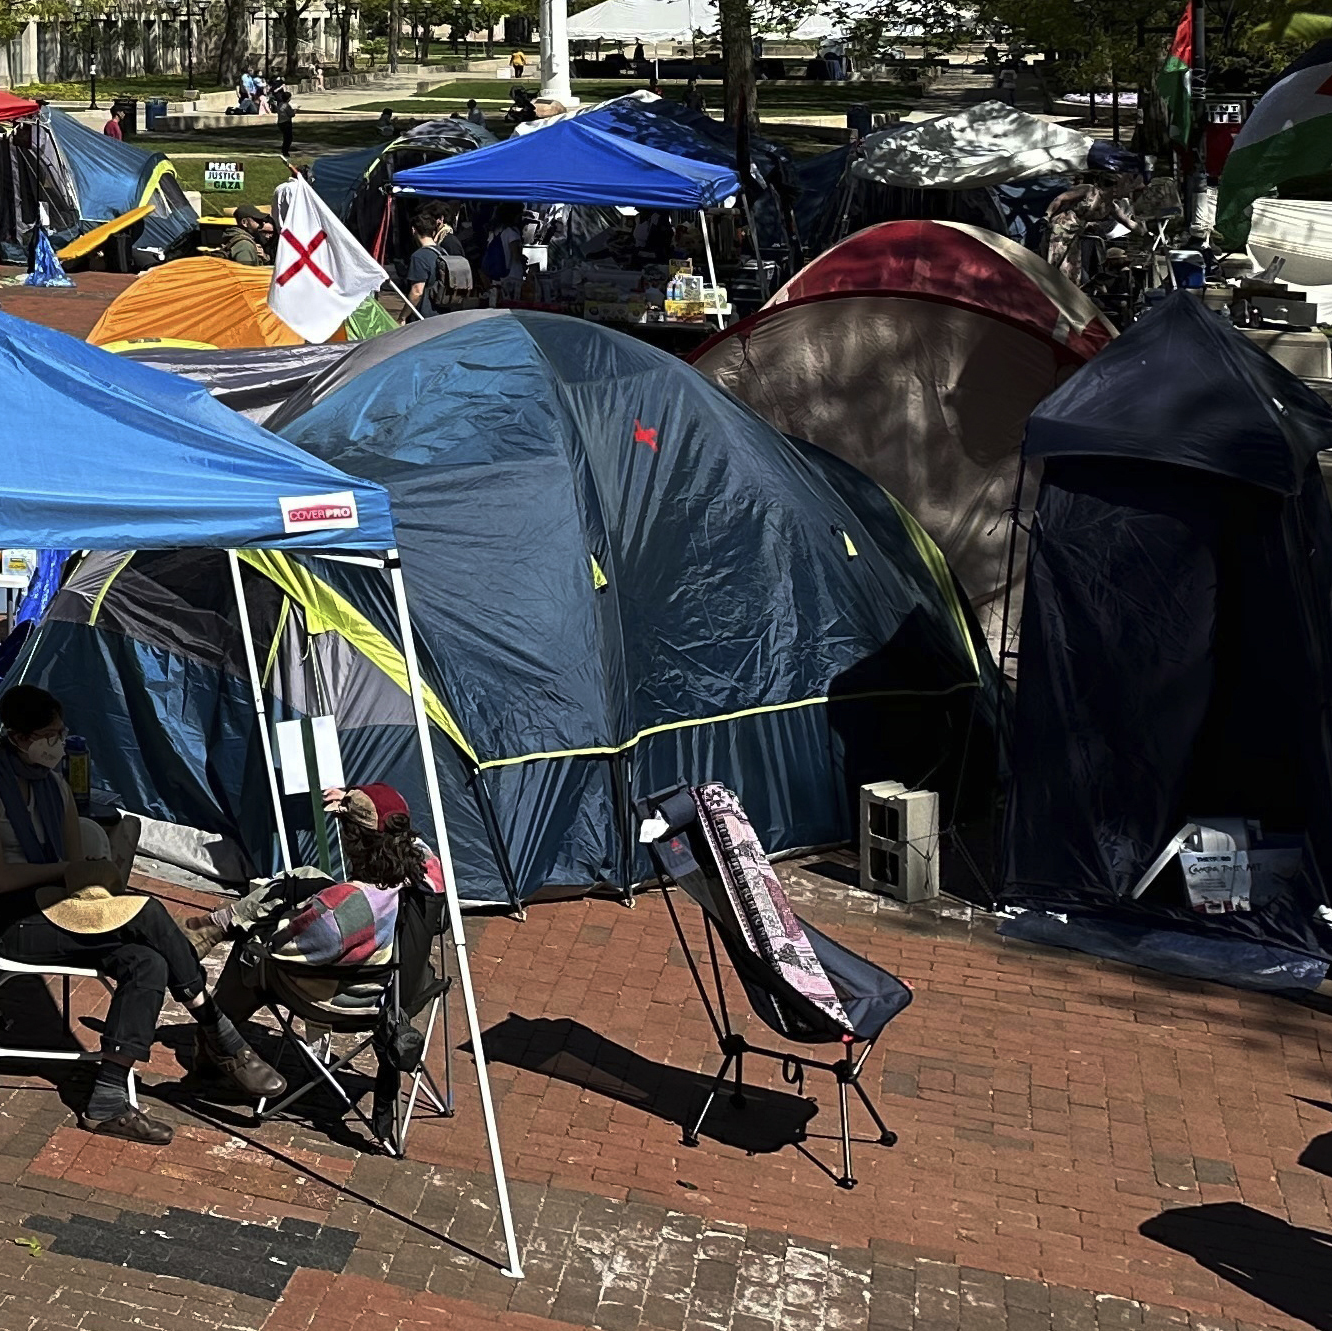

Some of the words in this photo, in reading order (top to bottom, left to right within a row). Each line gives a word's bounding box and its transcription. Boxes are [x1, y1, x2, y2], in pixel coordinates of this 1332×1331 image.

[208, 162, 237, 172] PEACE
[207, 171, 241, 181] JUSTICE
[213, 180, 241, 190] GAZA
[289, 507, 351, 521] COVERPRO
